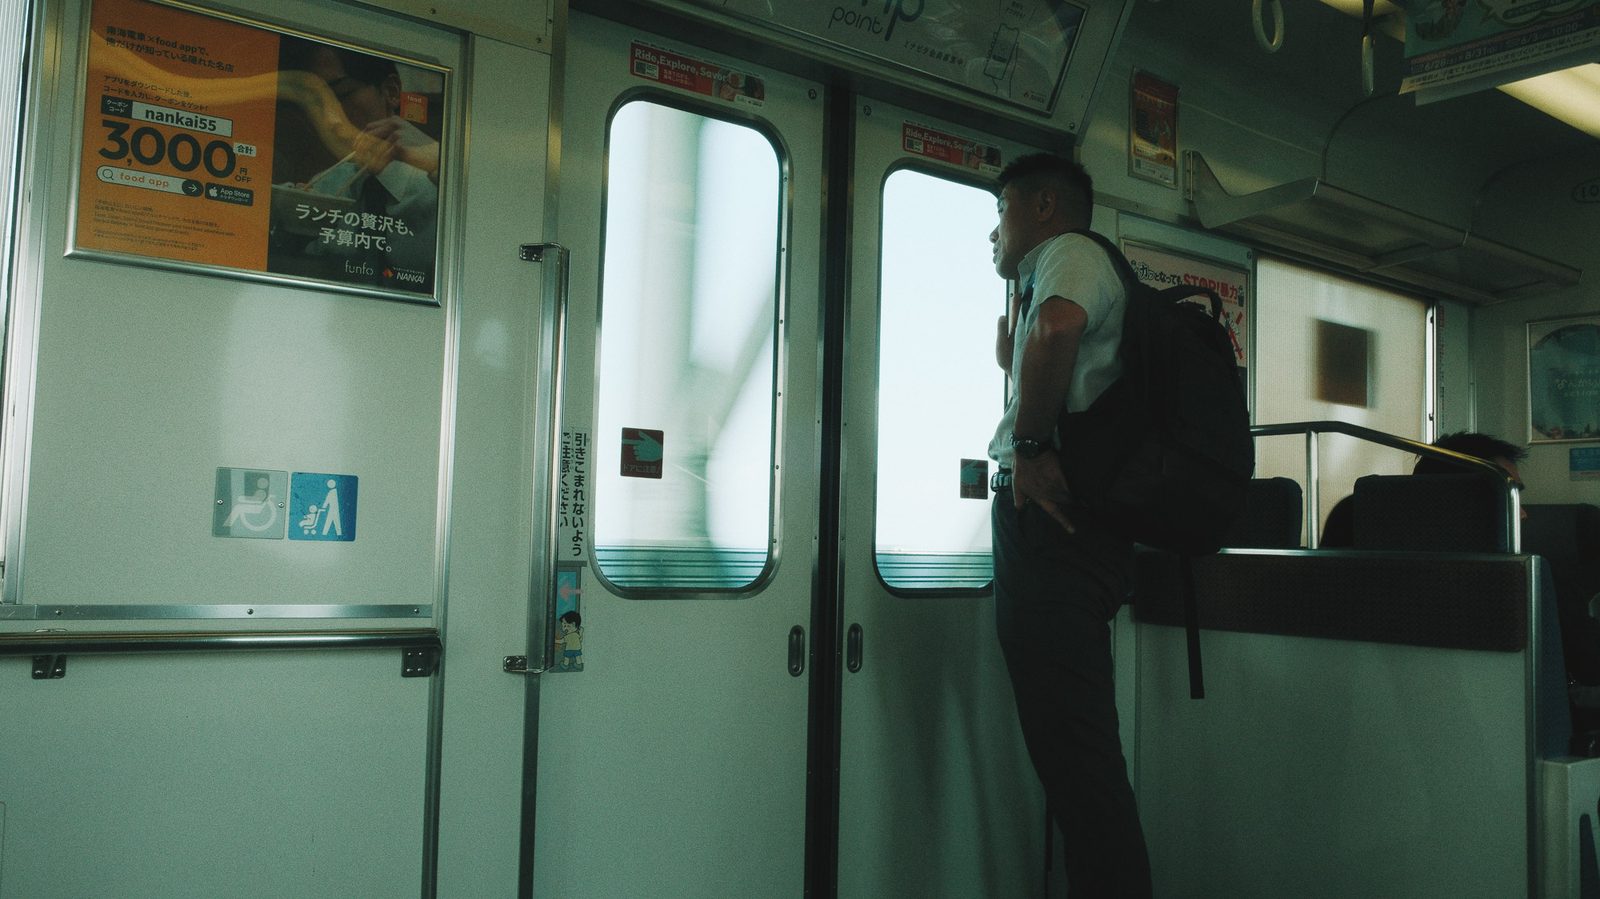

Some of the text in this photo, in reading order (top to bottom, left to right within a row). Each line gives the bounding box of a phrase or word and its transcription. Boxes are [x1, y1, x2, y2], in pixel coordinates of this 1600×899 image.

[828, 6, 883, 34] point
[106, 98, 129, 109] クーポン
[145, 108, 217, 132] nankai55
[98, 119, 237, 179] 3,000
[236, 144, 254, 155] 合計
[119, 171, 169, 189] food app
[235, 175, 252, 184] OFF
[239, 167, 248, 176] 円
[220, 187, 250, 199] App Store
[295, 203, 415, 237] ランチの贅沢も、
[319, 227, 392, 253] 予算内で。
[345, 259, 374, 276] funfo
[396, 272, 426, 284] NANKAI
[572, 433, 587, 557] 引きこまれないよう
